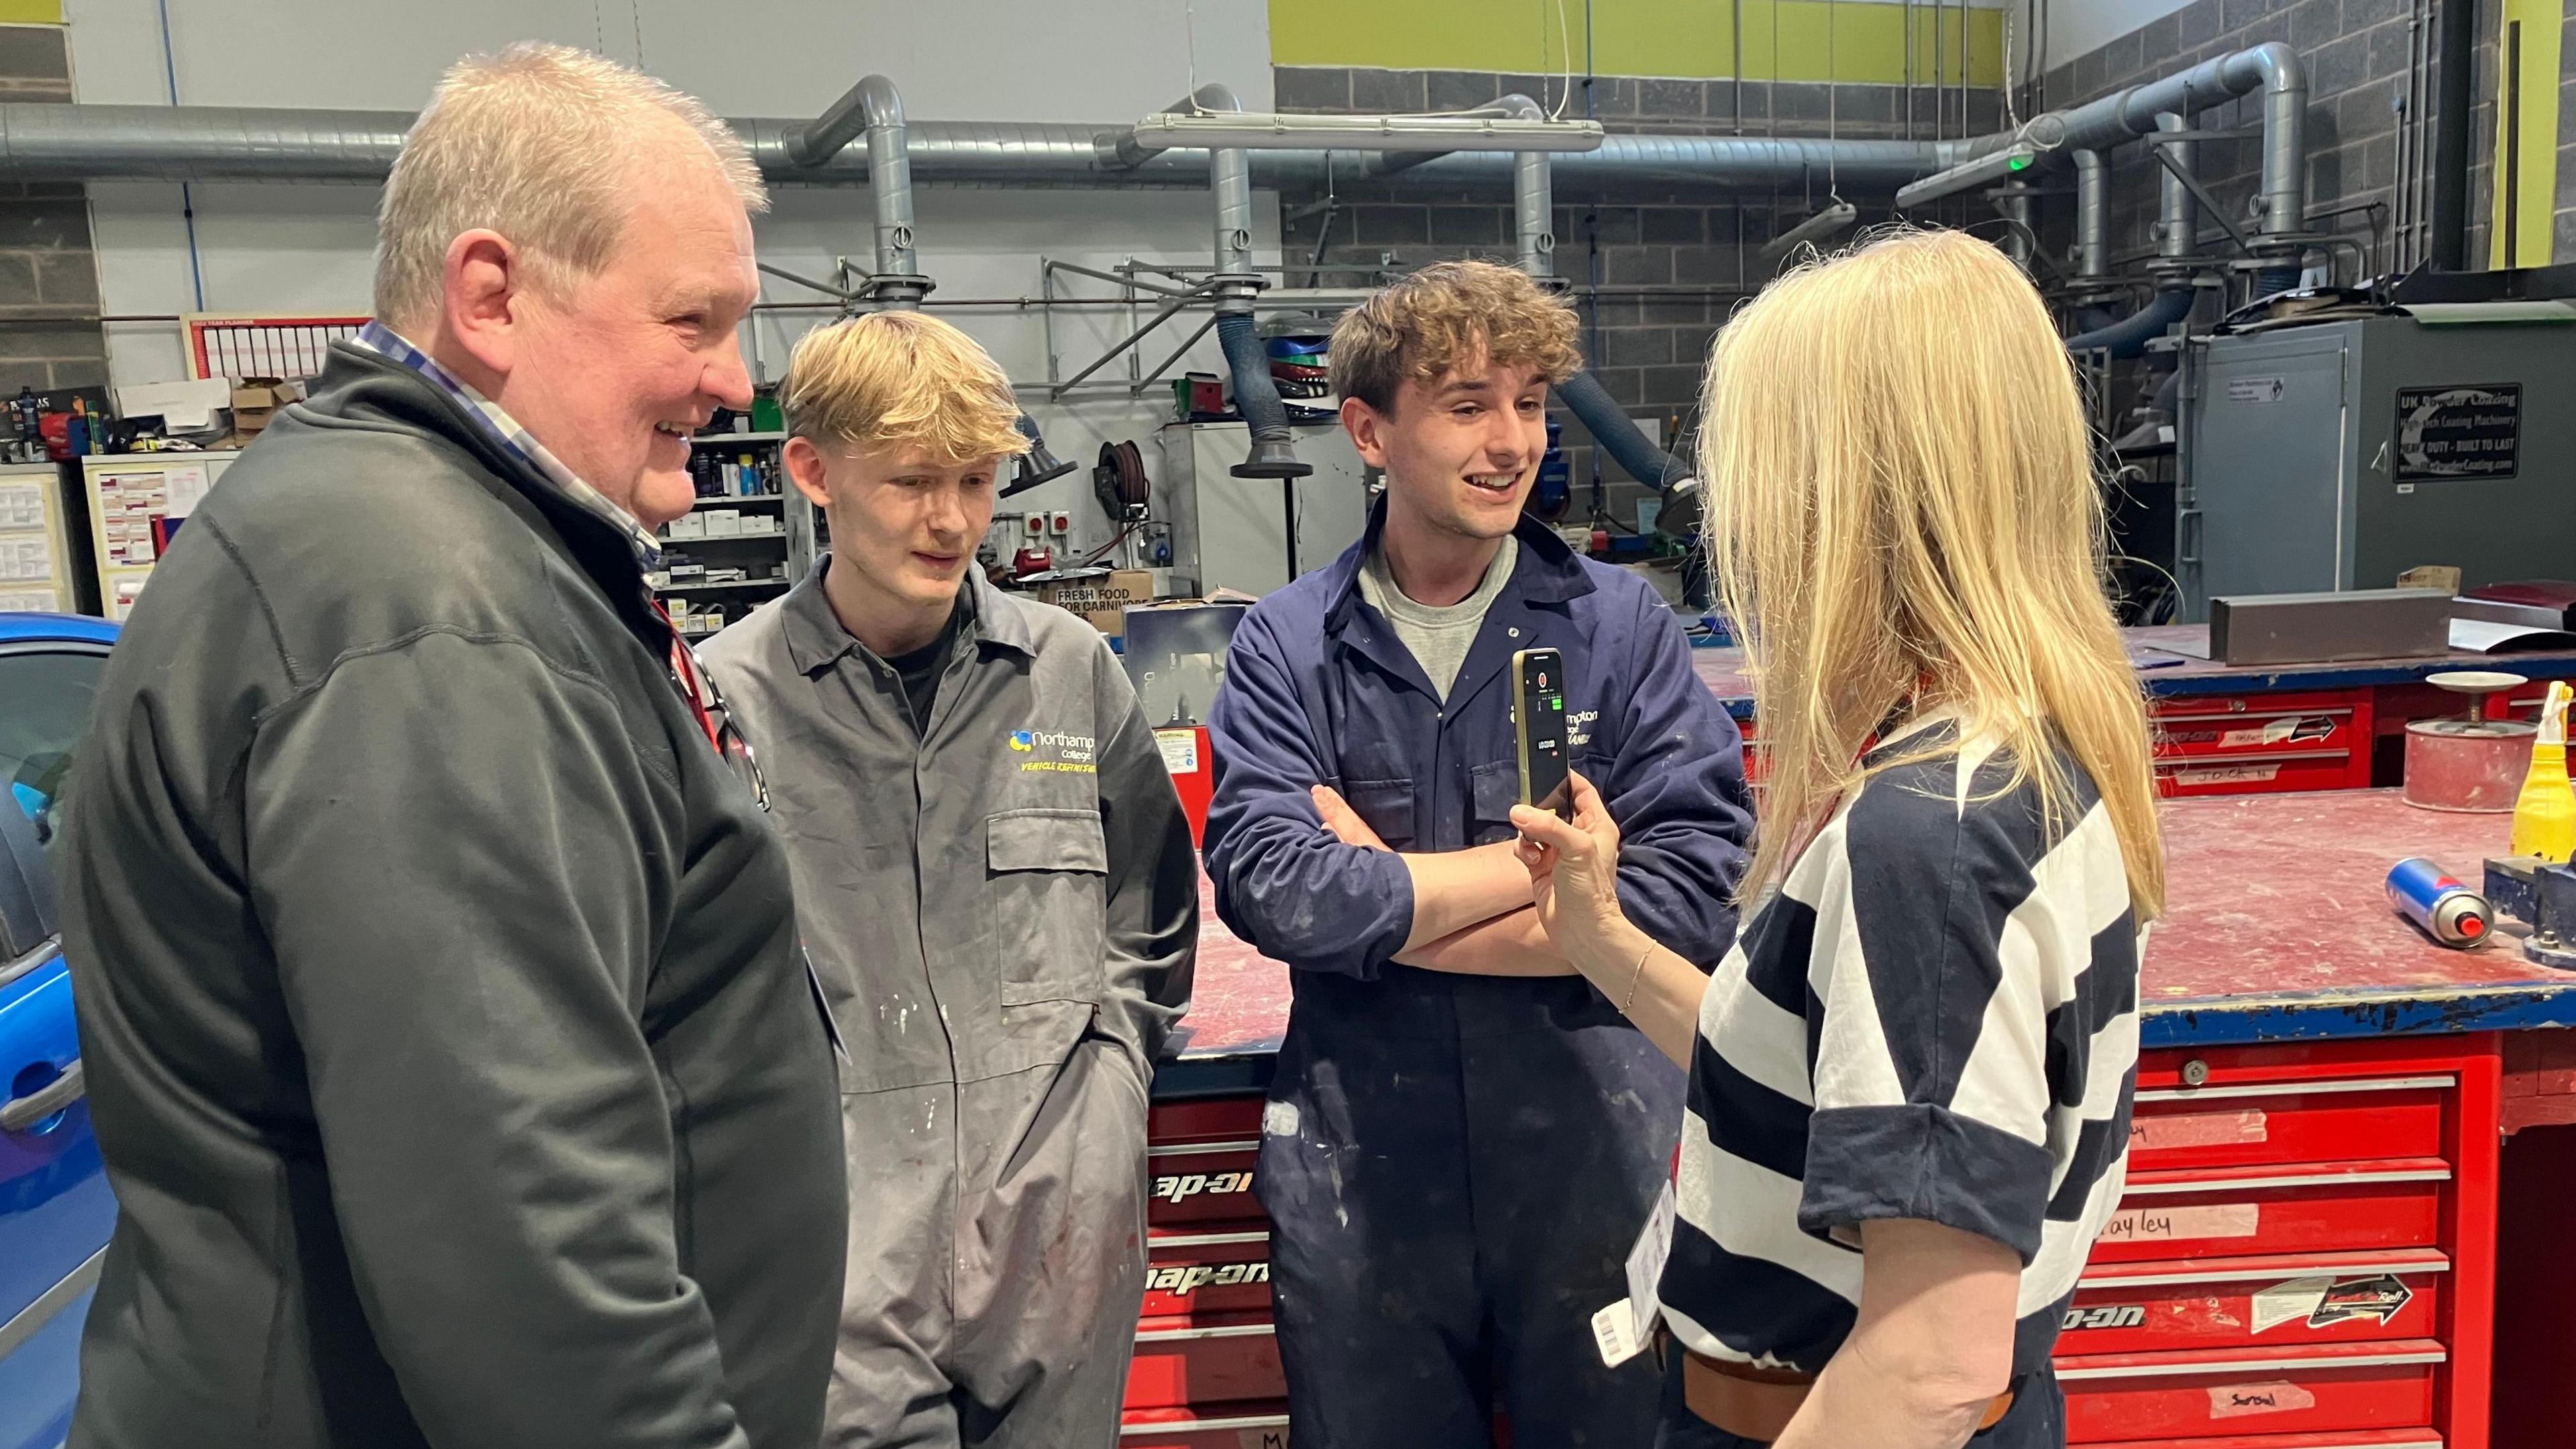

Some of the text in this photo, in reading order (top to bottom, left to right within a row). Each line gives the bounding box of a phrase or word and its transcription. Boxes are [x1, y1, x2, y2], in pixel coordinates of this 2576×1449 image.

[2401, 392, 2516, 409] UK Powder Coating
[2426, 441, 2449, 453] DUTY
[2456, 439, 2480, 452] BUILT
[2481, 439, 2493, 451] TO
[2495, 438, 2514, 450] LAST
[1058, 588, 1130, 602] FRESH FOOD
[1061, 749, 1092, 763] College
[1021, 762, 1057, 772] VEHICLE
[2100, 1210, 2171, 1239] ayley
